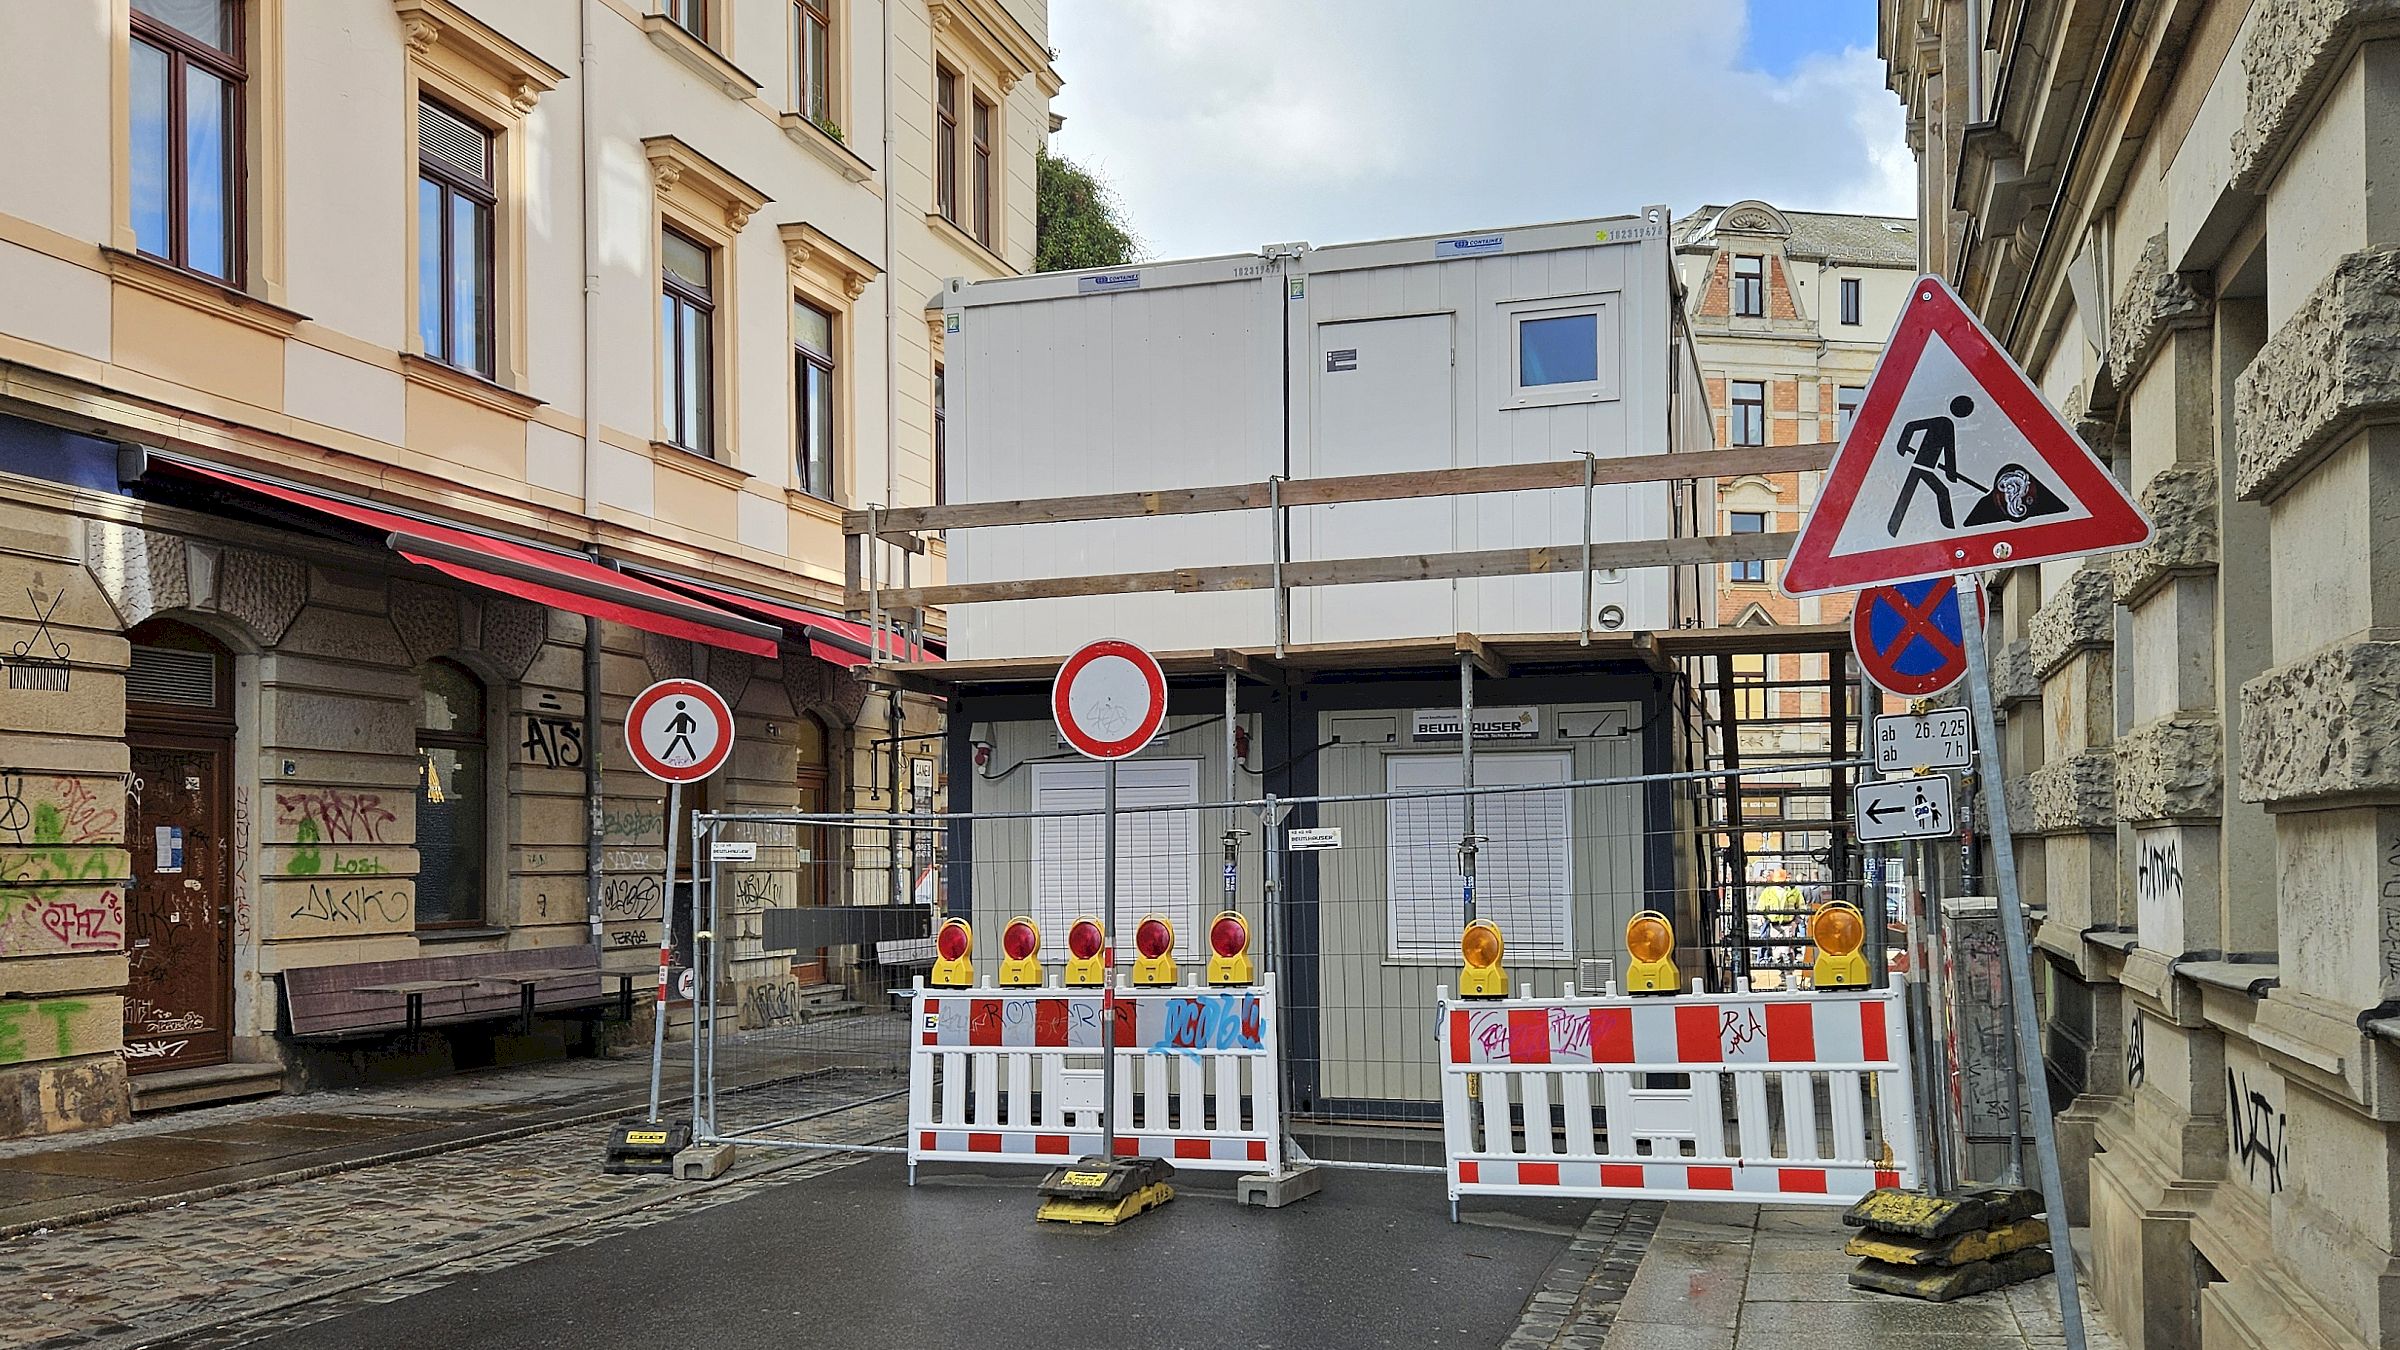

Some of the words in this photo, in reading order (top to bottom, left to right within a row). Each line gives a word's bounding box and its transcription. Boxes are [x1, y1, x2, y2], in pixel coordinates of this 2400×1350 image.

[1418, 721, 1522, 734] BEUTLAUSER
[1881, 725, 1896, 742] ab
[1914, 722, 1936, 739] 26.
[1883, 745, 1898, 762] ab
[1945, 741, 1952, 758] 7
[1956, 740, 1963, 757] h
